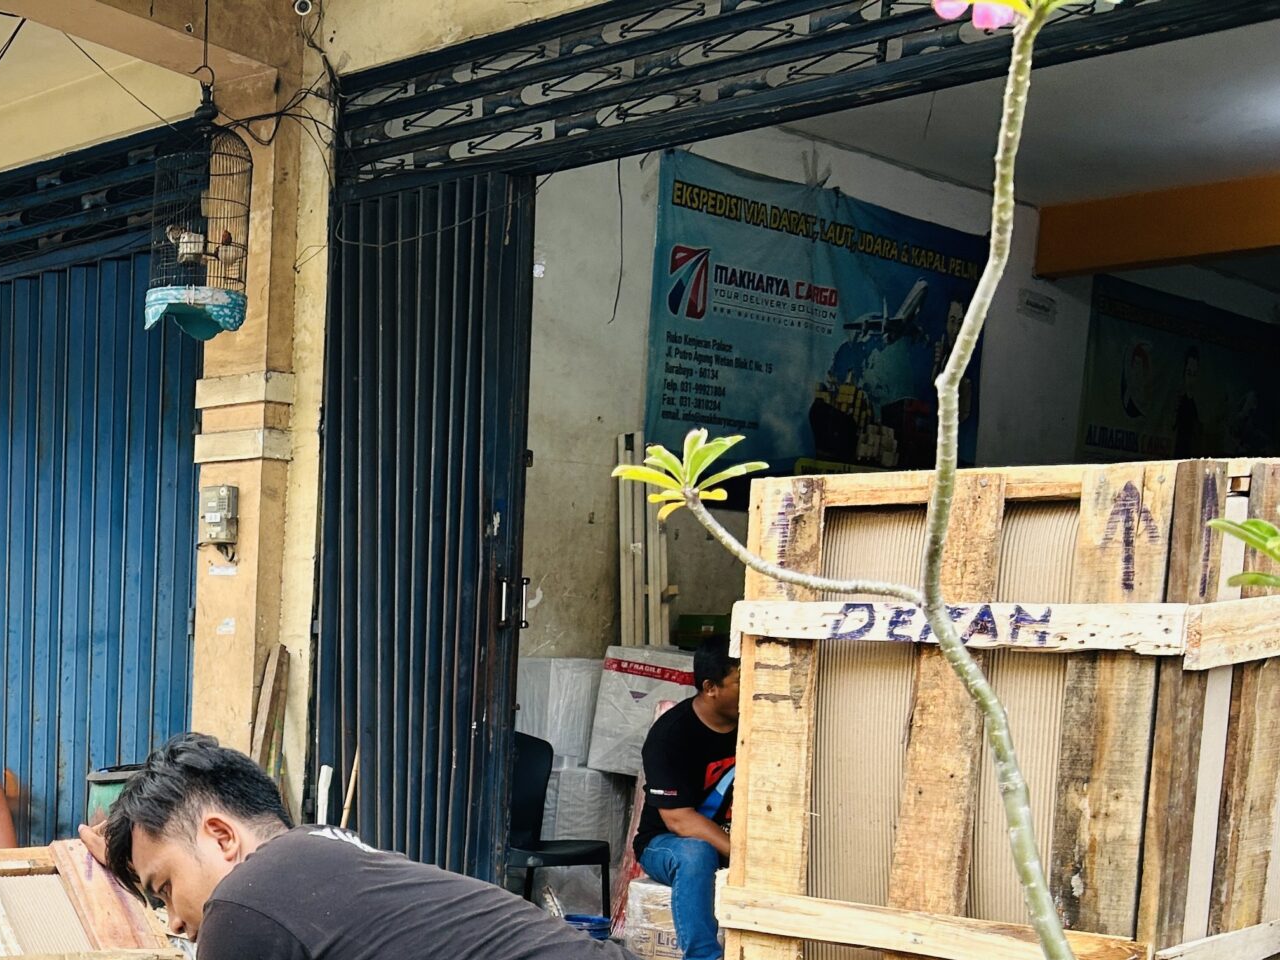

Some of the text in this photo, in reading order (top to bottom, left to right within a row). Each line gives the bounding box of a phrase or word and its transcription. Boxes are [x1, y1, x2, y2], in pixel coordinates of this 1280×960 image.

[672, 181, 742, 219] EKSPEDISI
[744, 198, 768, 229] VIA
[769, 204, 818, 242] DARAT,
[819, 217, 857, 251] LAUT,
[858, 228, 898, 260] UDARA
[900, 243, 909, 263] &
[910, 244, 946, 274] KAPAL
[714, 264, 838, 308] MAKHARYA CARGO
[713, 288, 837, 321] YOUR DELIVERY SOLUTION
[629, 662, 662, 675] FRAGILE
[657, 932, 679, 950] Lig
